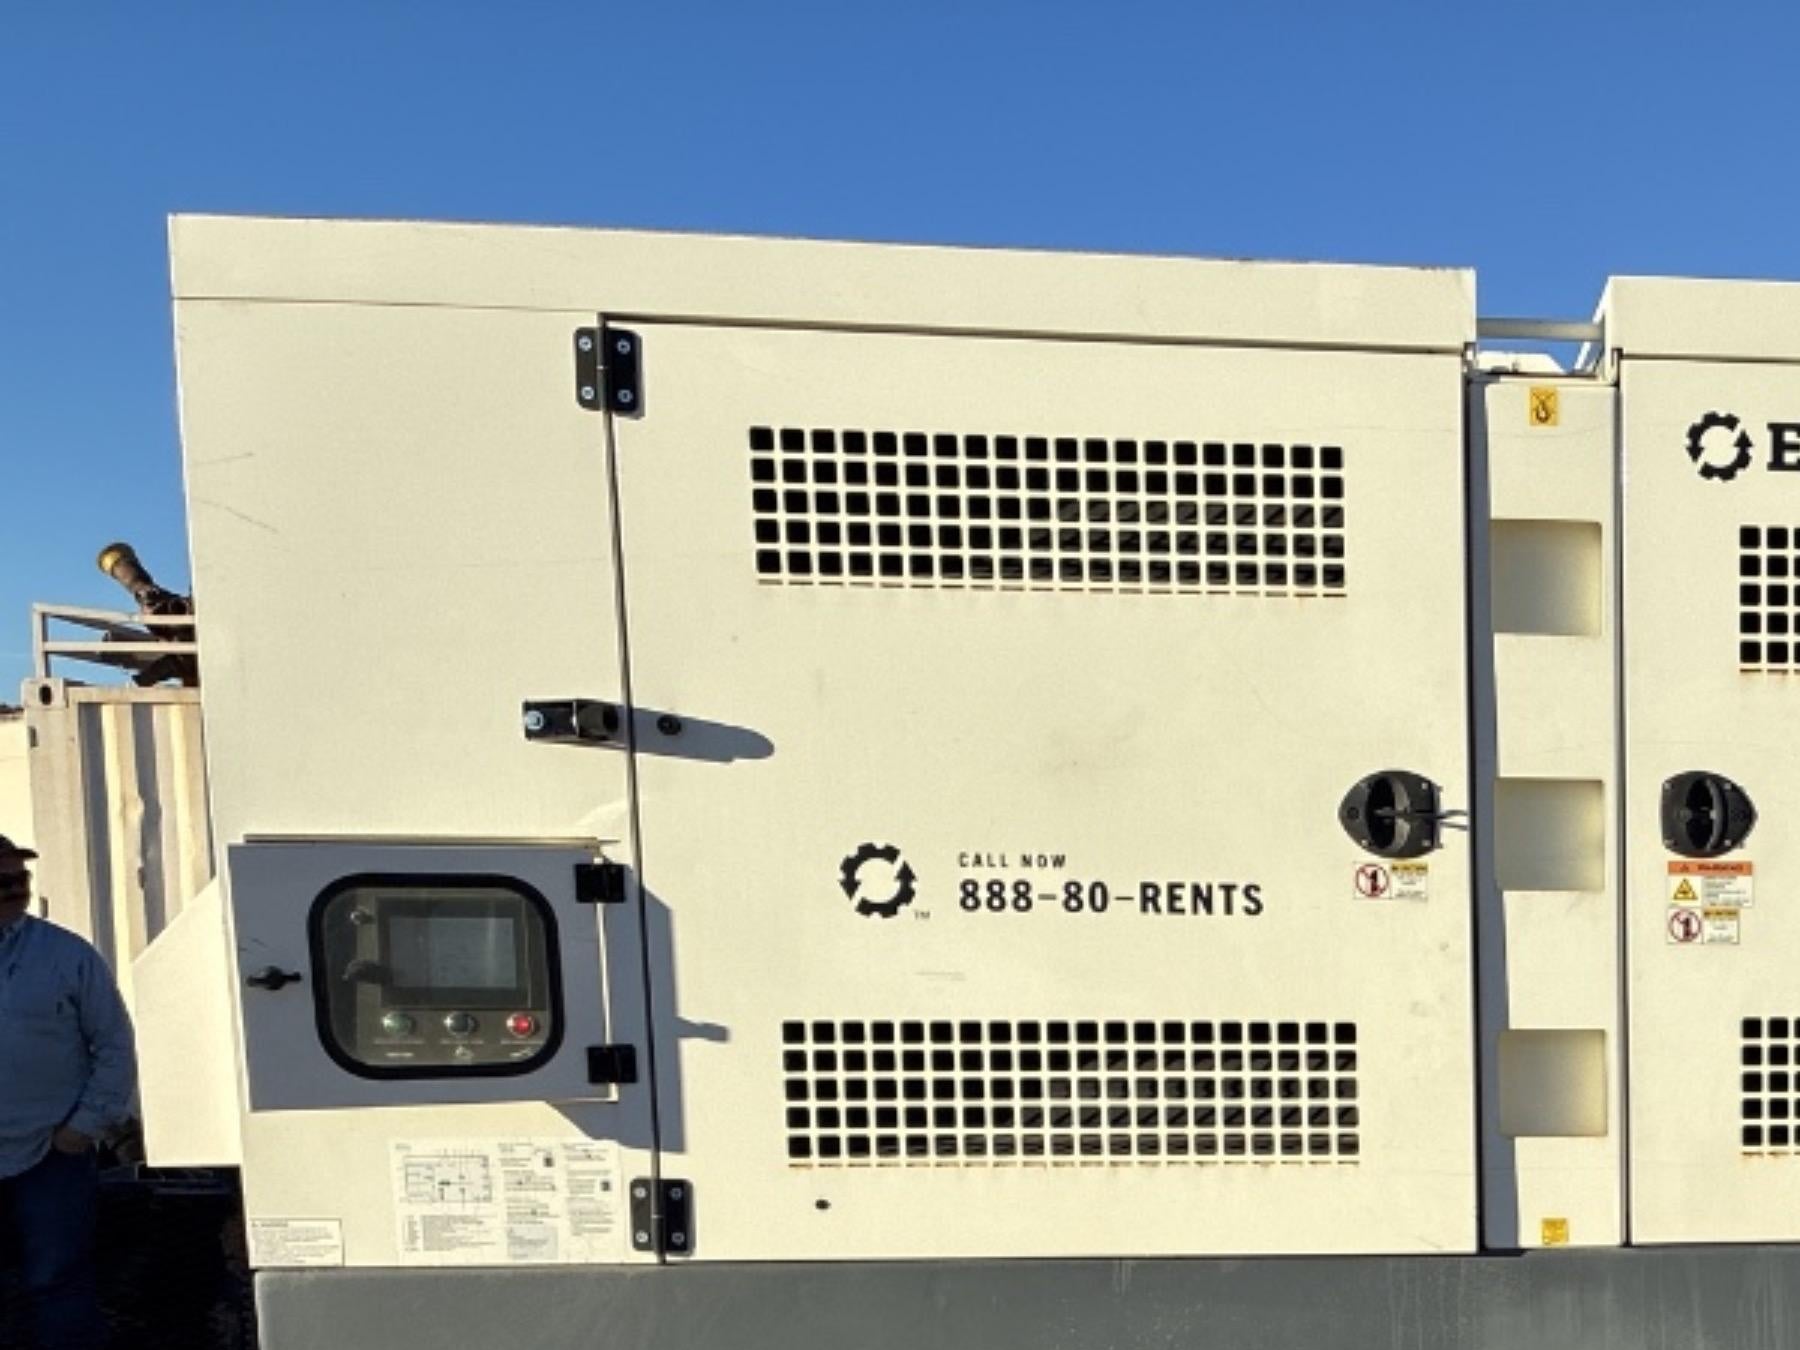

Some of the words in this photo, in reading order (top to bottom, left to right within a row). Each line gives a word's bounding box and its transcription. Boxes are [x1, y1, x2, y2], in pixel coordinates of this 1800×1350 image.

[958, 852, 1009, 868] CALL
[1020, 853, 1067, 869] NOW
[958, 878, 1265, 916] 888-80-RENTS
